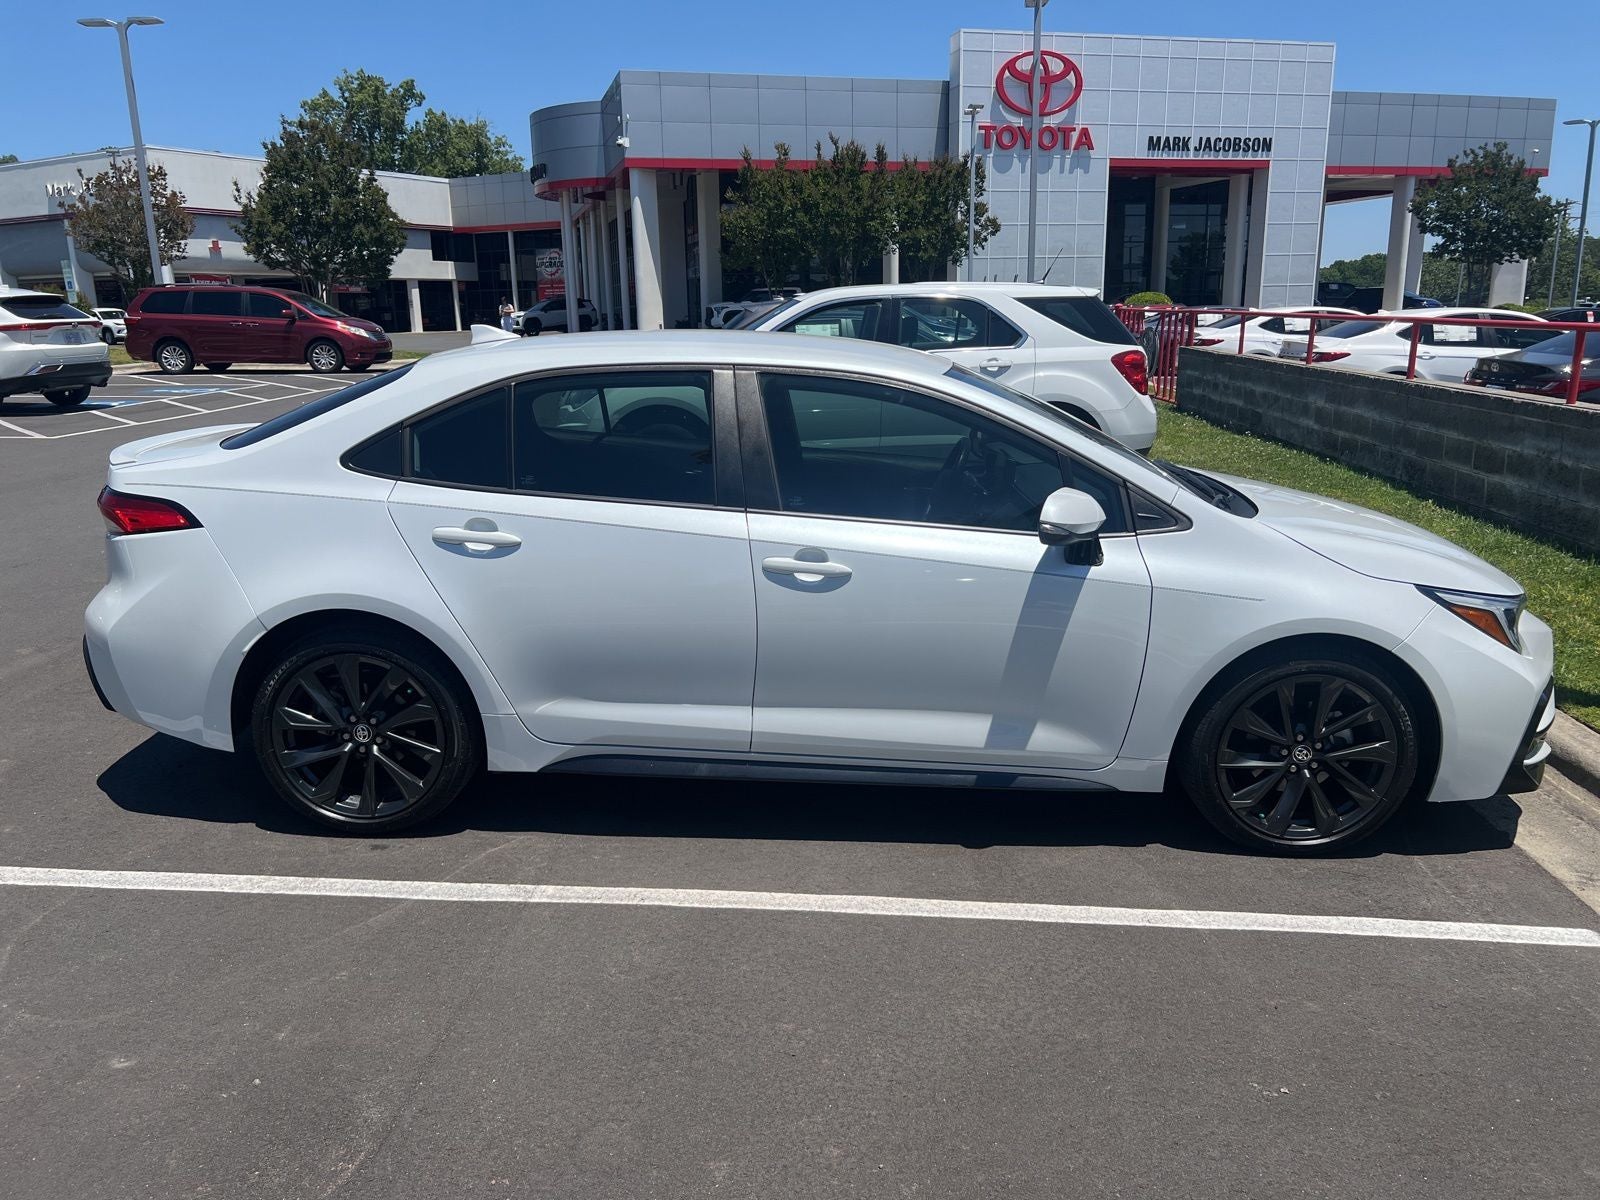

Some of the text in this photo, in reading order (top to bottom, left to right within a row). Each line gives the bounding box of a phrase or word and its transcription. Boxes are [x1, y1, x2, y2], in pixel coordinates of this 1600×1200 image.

[979, 125, 1095, 151] TOYOTA
[1147, 136, 1273, 153] MARK JACOBSON
[45, 181, 77, 198] Mark
